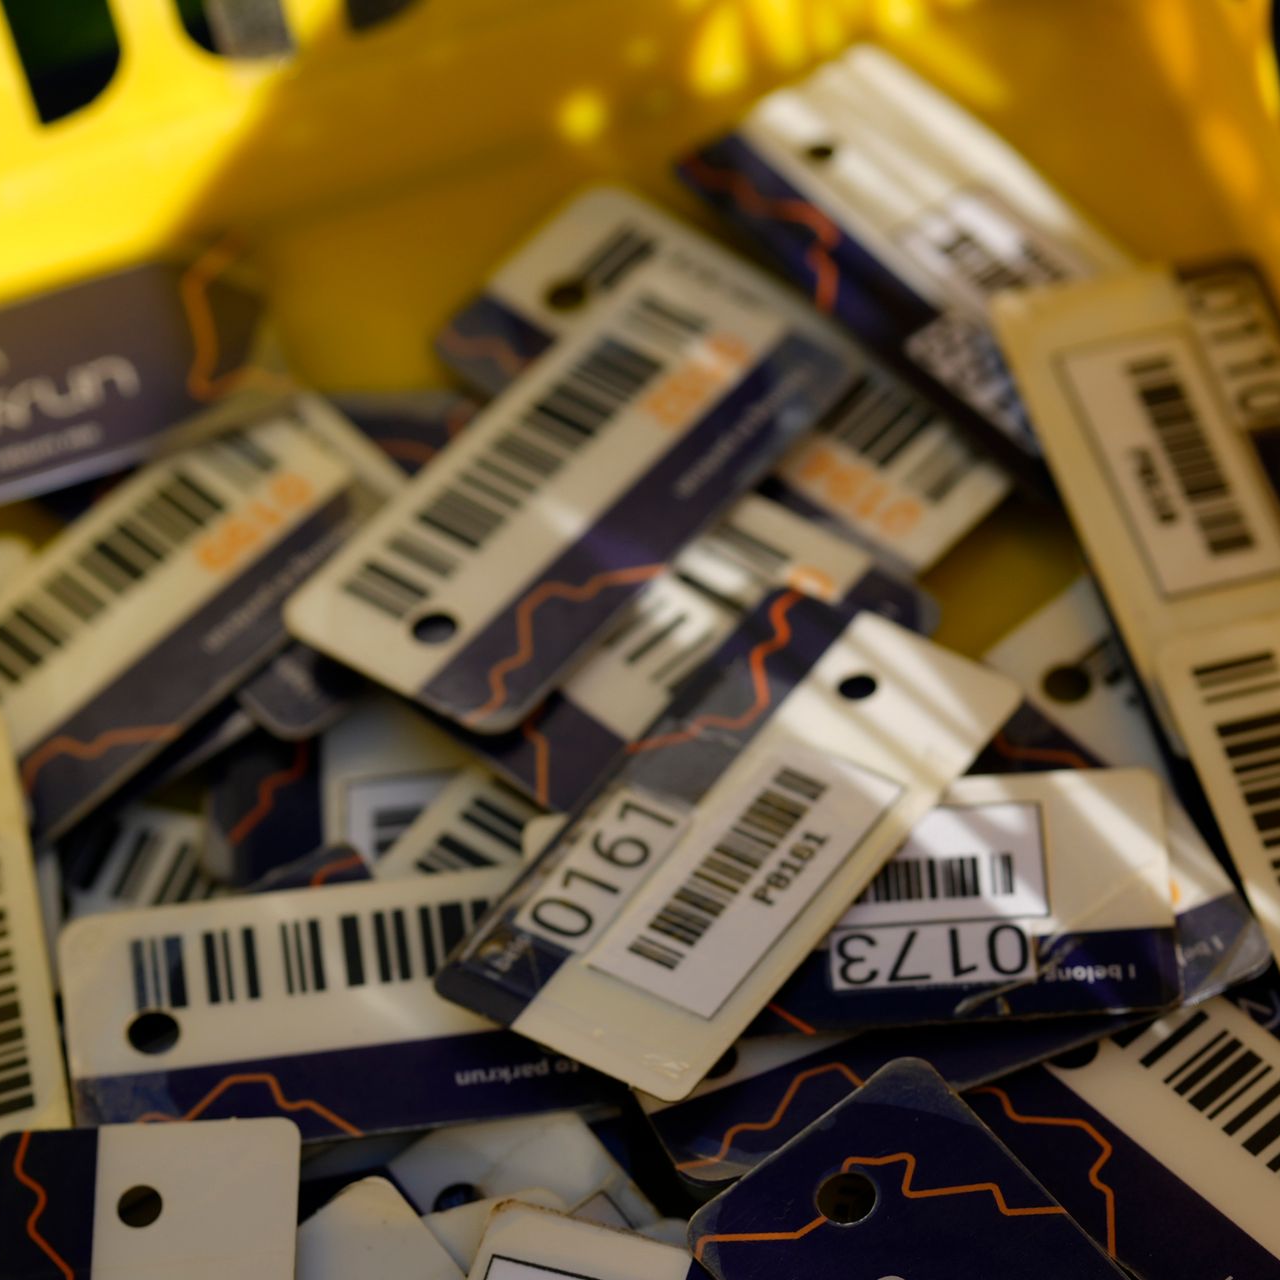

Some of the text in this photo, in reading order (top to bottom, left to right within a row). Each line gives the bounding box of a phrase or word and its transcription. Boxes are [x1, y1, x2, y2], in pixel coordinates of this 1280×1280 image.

[532, 800, 676, 938] 0161
[837, 924, 1029, 984] 0173
[454, 1056, 550, 1087] parkrun
